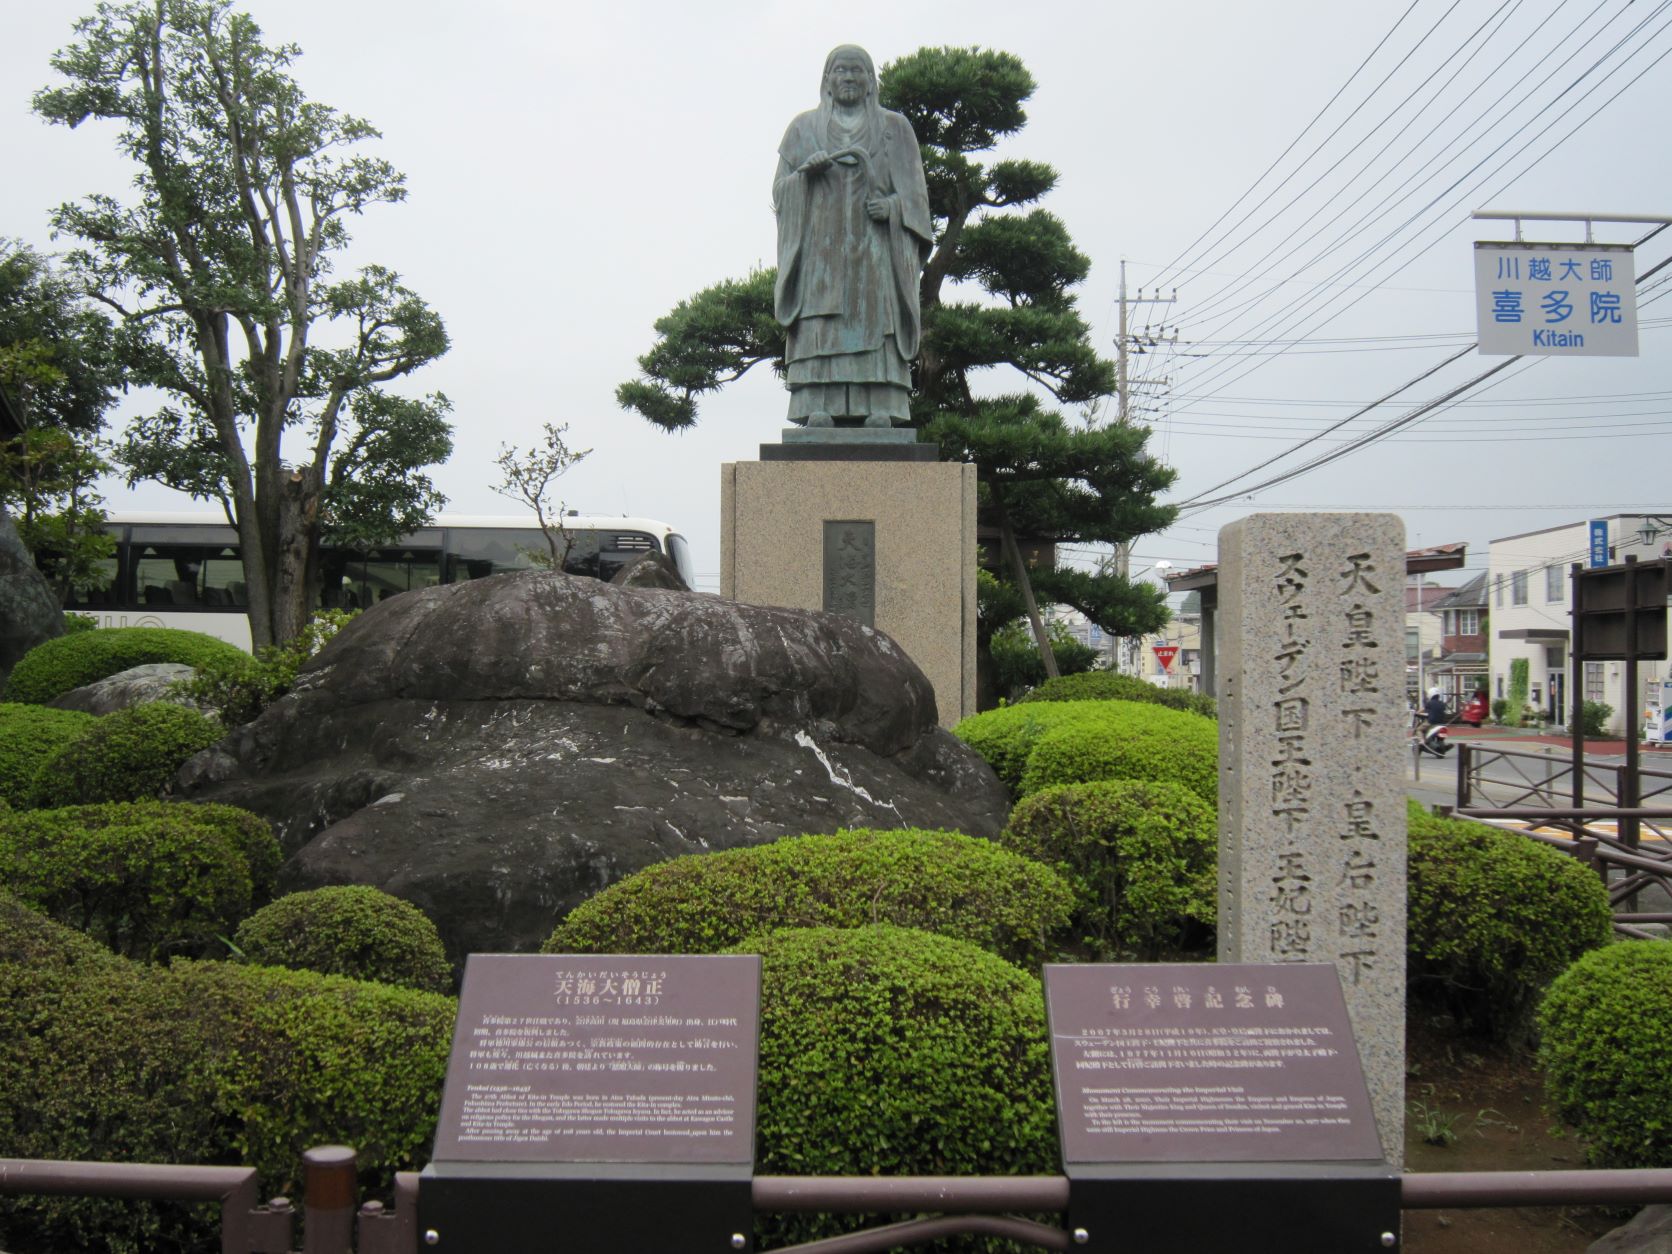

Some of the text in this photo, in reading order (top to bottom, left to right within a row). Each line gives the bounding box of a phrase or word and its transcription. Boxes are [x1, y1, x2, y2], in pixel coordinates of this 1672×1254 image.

[1497, 256, 1613, 282] 川越大師
[1491, 289, 1622, 324] 喜多院
[1533, 329, 1584, 347] Kitain
[1270, 552, 1311, 969] スウェーデン国王陛下・王妃陛
[554, 979, 663, 995] 天海大僧正
